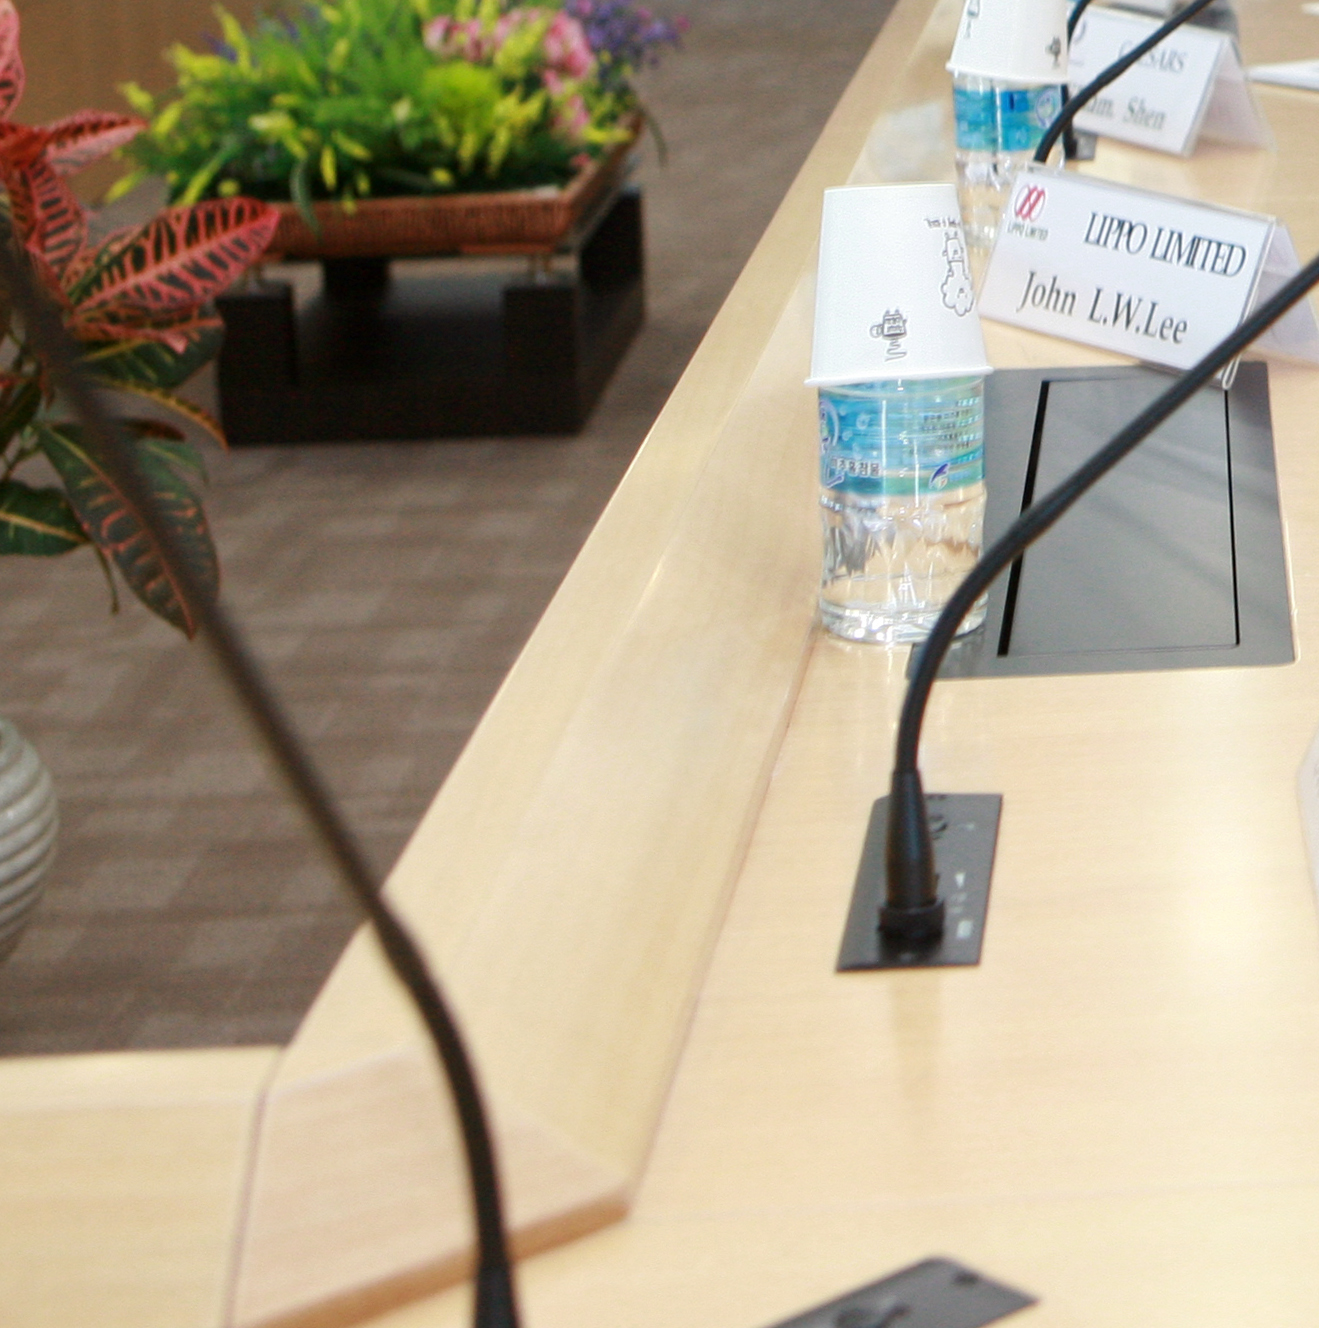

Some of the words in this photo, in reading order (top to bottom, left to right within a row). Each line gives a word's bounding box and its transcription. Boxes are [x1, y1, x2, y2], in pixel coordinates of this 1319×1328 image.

[1118, 39, 1188, 74] CSARS
[1084, 211, 1148, 255] LIPPO
[1150, 226, 1247, 278] LIMITED
[1016, 270, 1076, 313] John
